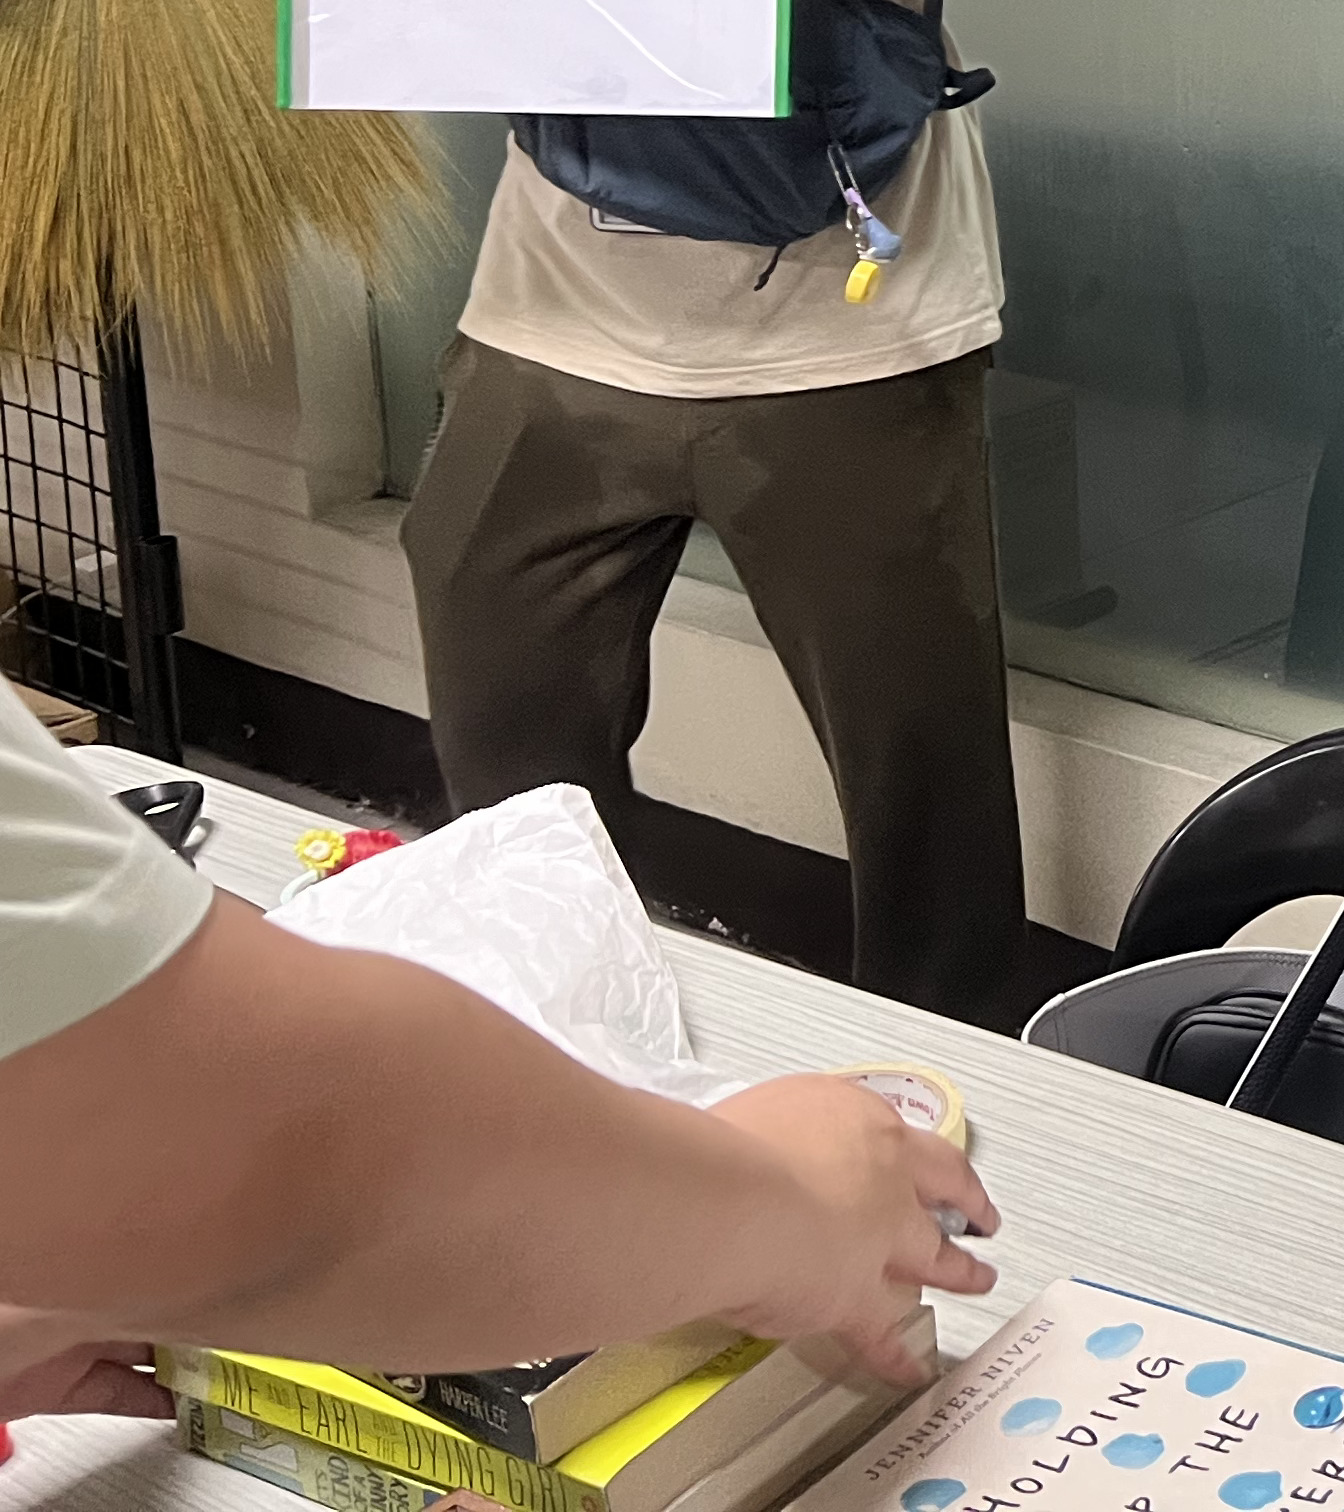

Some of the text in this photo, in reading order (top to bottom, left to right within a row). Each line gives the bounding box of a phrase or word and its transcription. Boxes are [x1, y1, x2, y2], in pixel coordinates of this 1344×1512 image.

[221, 1359, 260, 1417] ME
[295, 1383, 368, 1454] EARL
[403, 1421, 495, 1496] DYING
[483, 1401, 508, 1433] LEE
[864, 1317, 1056, 1482] JENNIFER NIVEN
[963, 1356, 1184, 1512] HOLDING
[1168, 1405, 1259, 1474] THE
